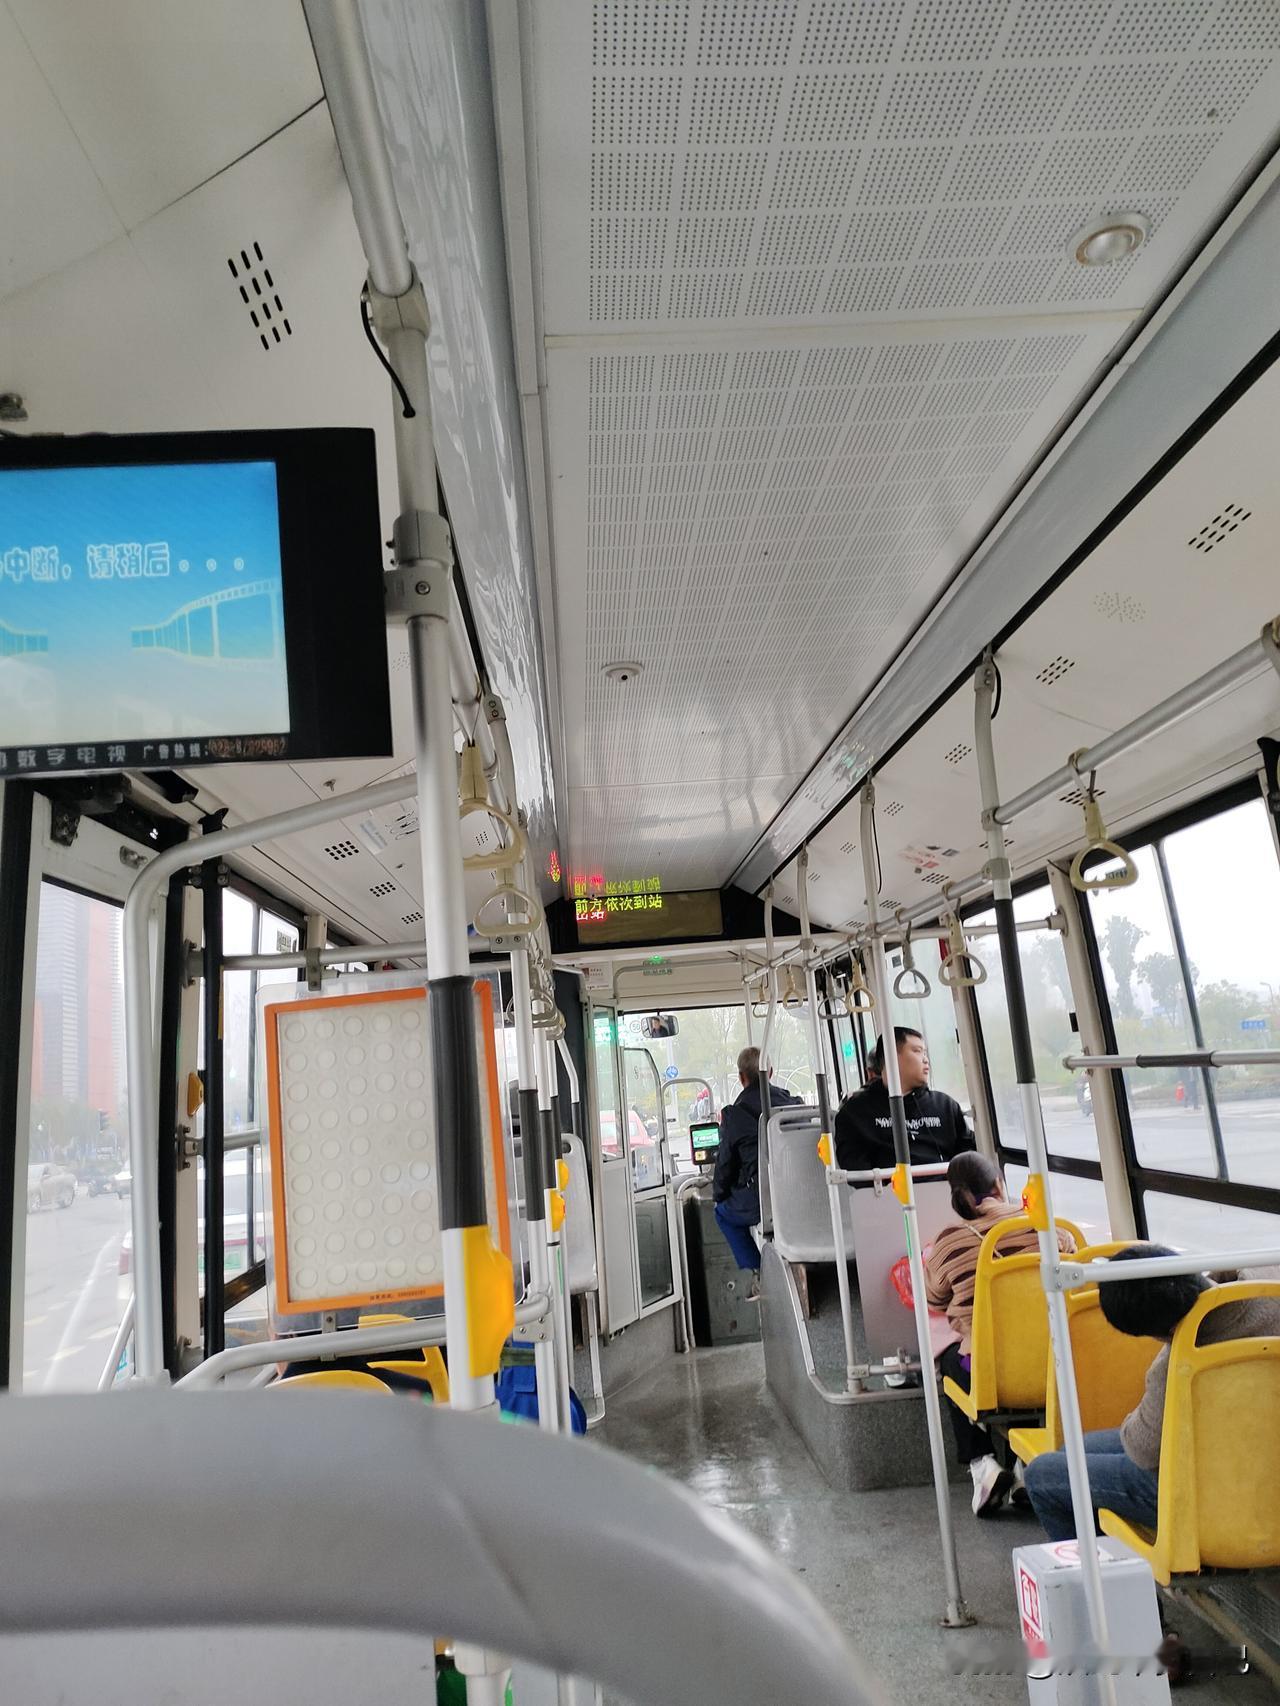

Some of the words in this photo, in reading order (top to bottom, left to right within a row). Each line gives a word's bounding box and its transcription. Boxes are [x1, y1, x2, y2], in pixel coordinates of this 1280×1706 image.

[574, 893, 662, 914] 前方依次到站
